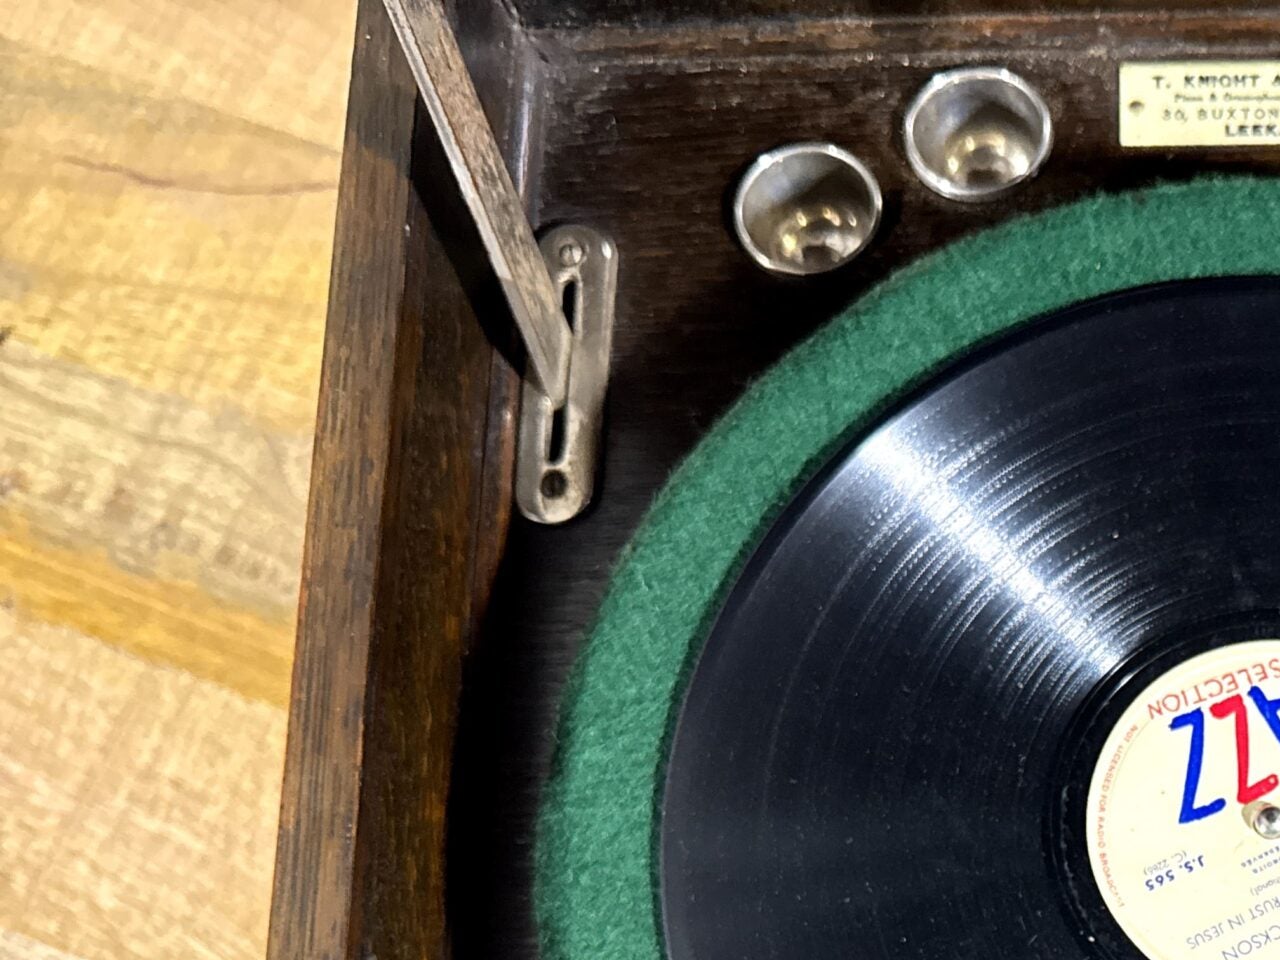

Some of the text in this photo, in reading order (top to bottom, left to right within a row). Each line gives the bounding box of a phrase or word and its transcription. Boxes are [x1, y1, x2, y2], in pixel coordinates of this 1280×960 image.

[1152, 75, 1171, 89] T.
[1184, 75, 1260, 88] KNIGHT
[1197, 108, 1279, 121] BUXTON
[1145, 869, 1175, 892] 565
[1227, 913, 1246, 930] IN
[1186, 922, 1225, 950] JESUS
